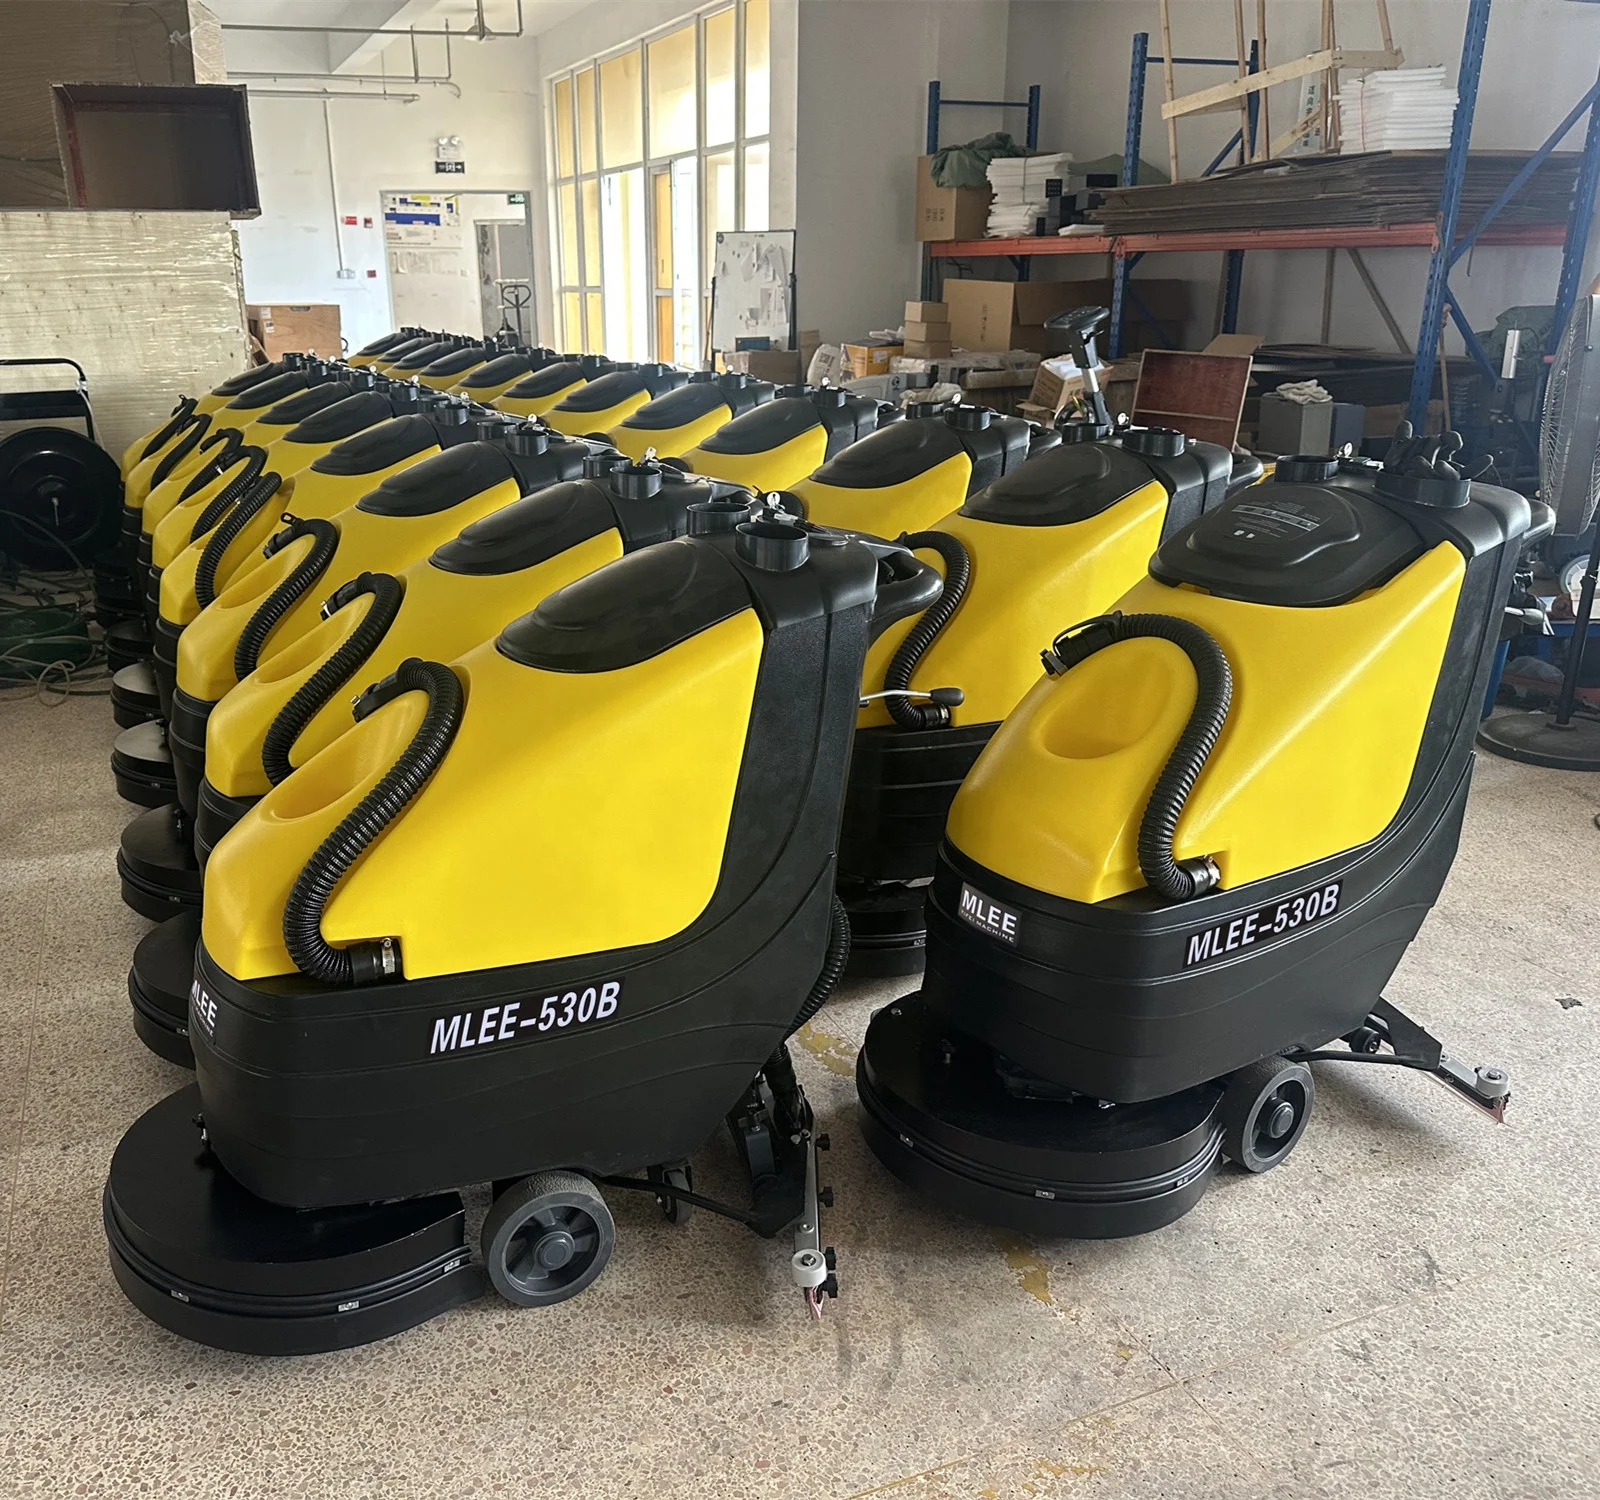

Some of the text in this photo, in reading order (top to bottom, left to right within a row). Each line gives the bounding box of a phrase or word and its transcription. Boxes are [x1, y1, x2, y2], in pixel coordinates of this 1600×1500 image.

[962, 889, 1017, 935] MLEE
[976, 920, 1015, 943] MACHINE
[1187, 884, 1340, 965] MLEE-530B
[430, 981, 620, 1054] MLEE-530B
